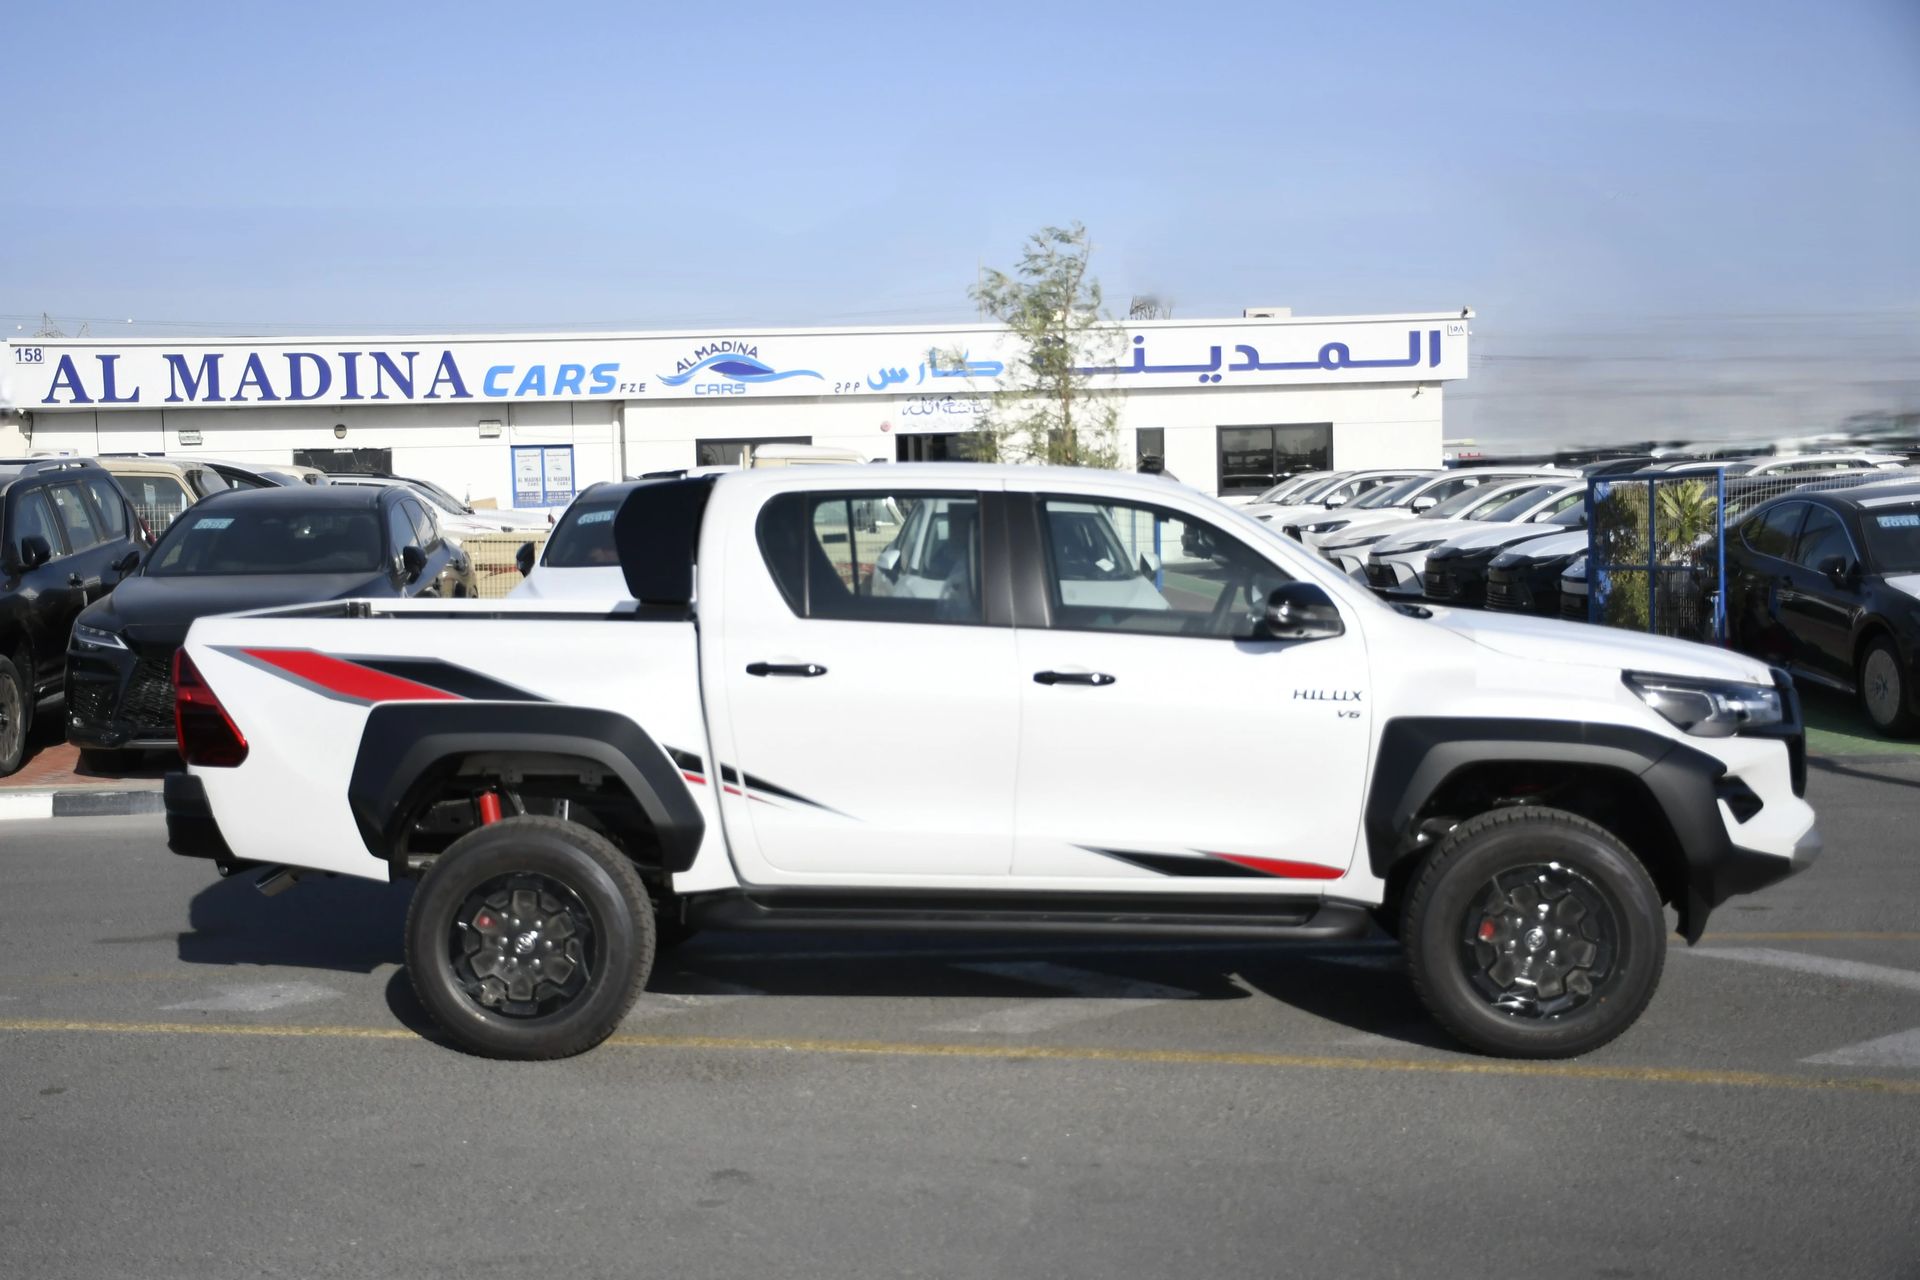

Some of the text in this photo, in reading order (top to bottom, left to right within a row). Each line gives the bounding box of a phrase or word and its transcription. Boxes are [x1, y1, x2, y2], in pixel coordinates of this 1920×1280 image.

[15, 347, 42, 363] 158
[677, 341, 758, 374] AL MADINA
[41, 350, 646, 404] AL MADINA CARS FZE
[695, 383, 746, 395] CARS
[1293, 689, 1361, 701] HILUX
[1337, 710, 1360, 718] V6
